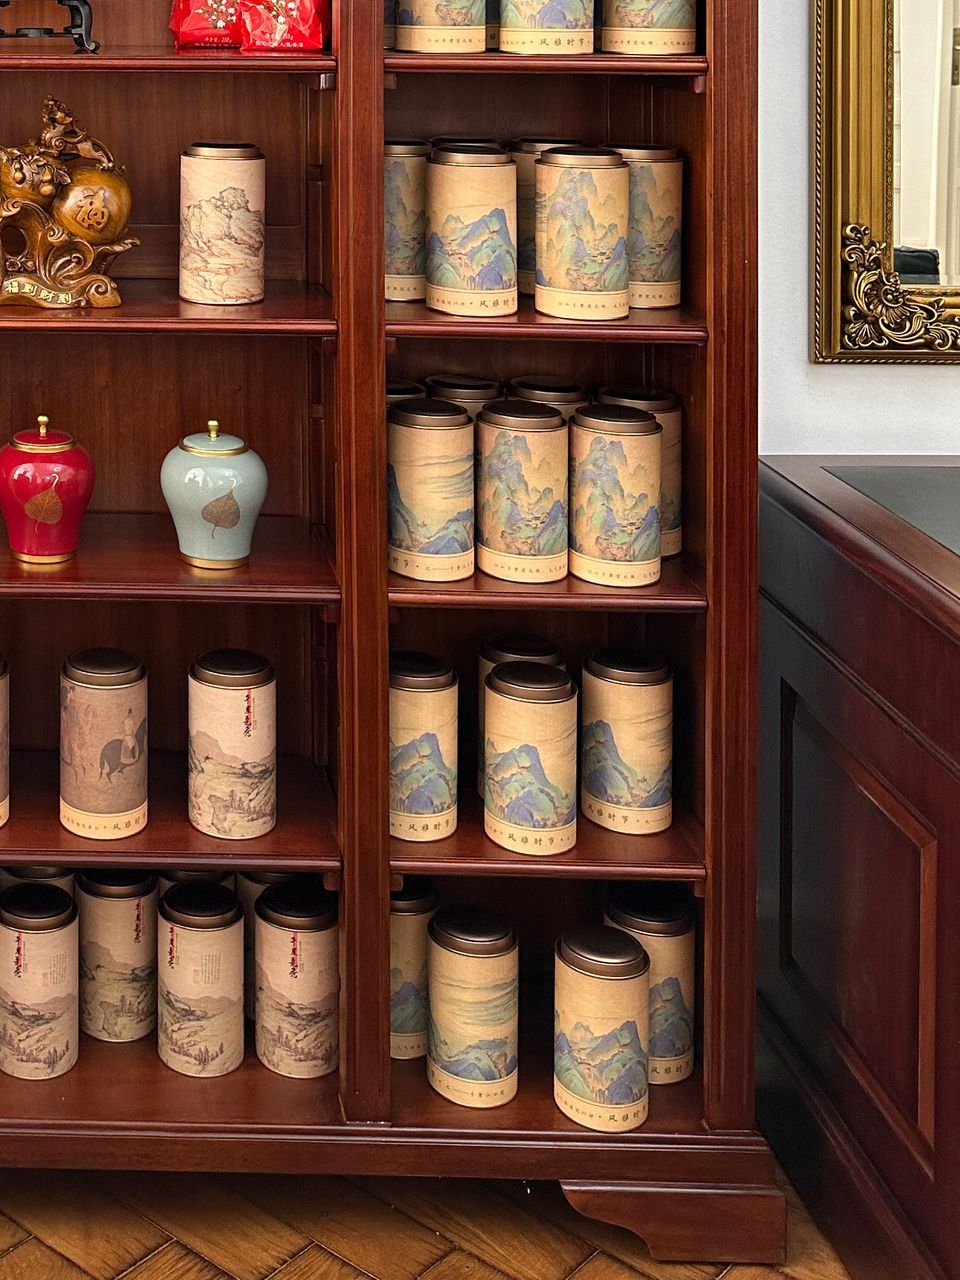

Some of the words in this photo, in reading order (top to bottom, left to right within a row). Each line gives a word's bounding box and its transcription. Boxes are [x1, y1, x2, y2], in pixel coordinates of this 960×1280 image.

[76, 188, 109, 229] 福
[4, 281, 72, 304] 福到财到
